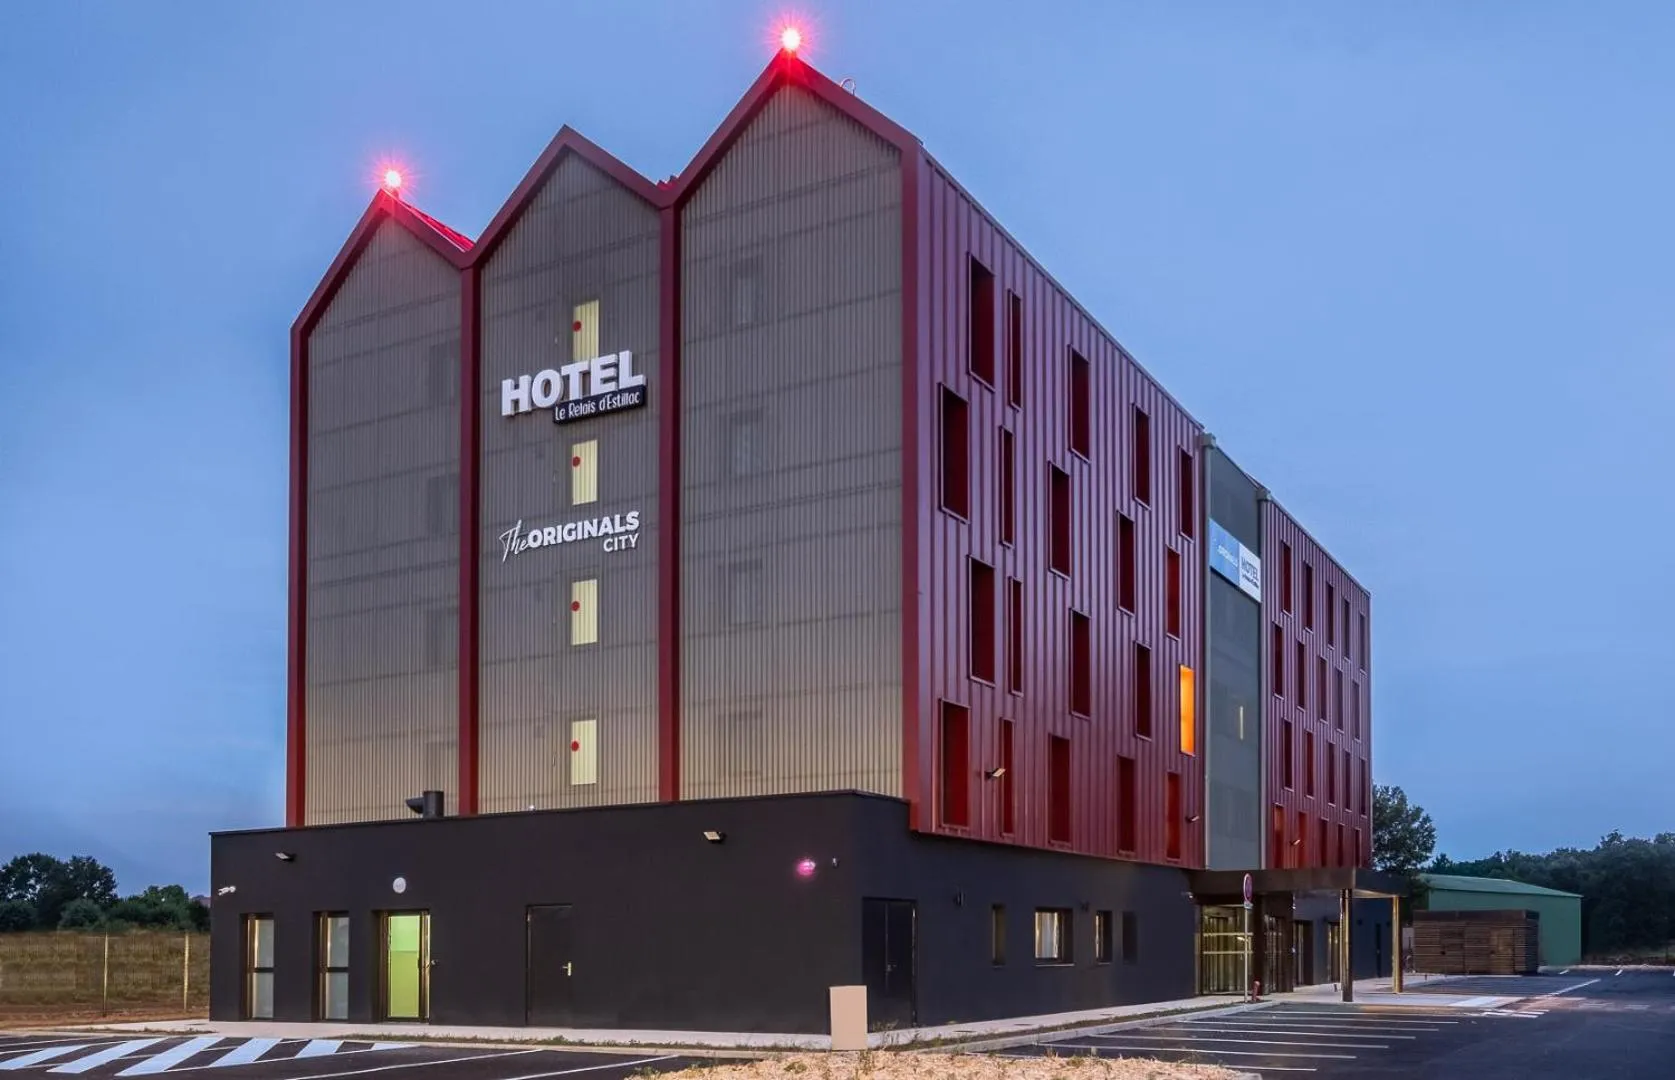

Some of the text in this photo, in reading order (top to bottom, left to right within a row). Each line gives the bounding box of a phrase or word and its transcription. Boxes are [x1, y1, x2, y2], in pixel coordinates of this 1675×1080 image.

[501, 350, 646, 417] HOTEL
[555, 391, 640, 421] Le Relais d'Estillac
[499, 511, 640, 563] The ORIGINALS
[603, 533, 640, 553] CITY
